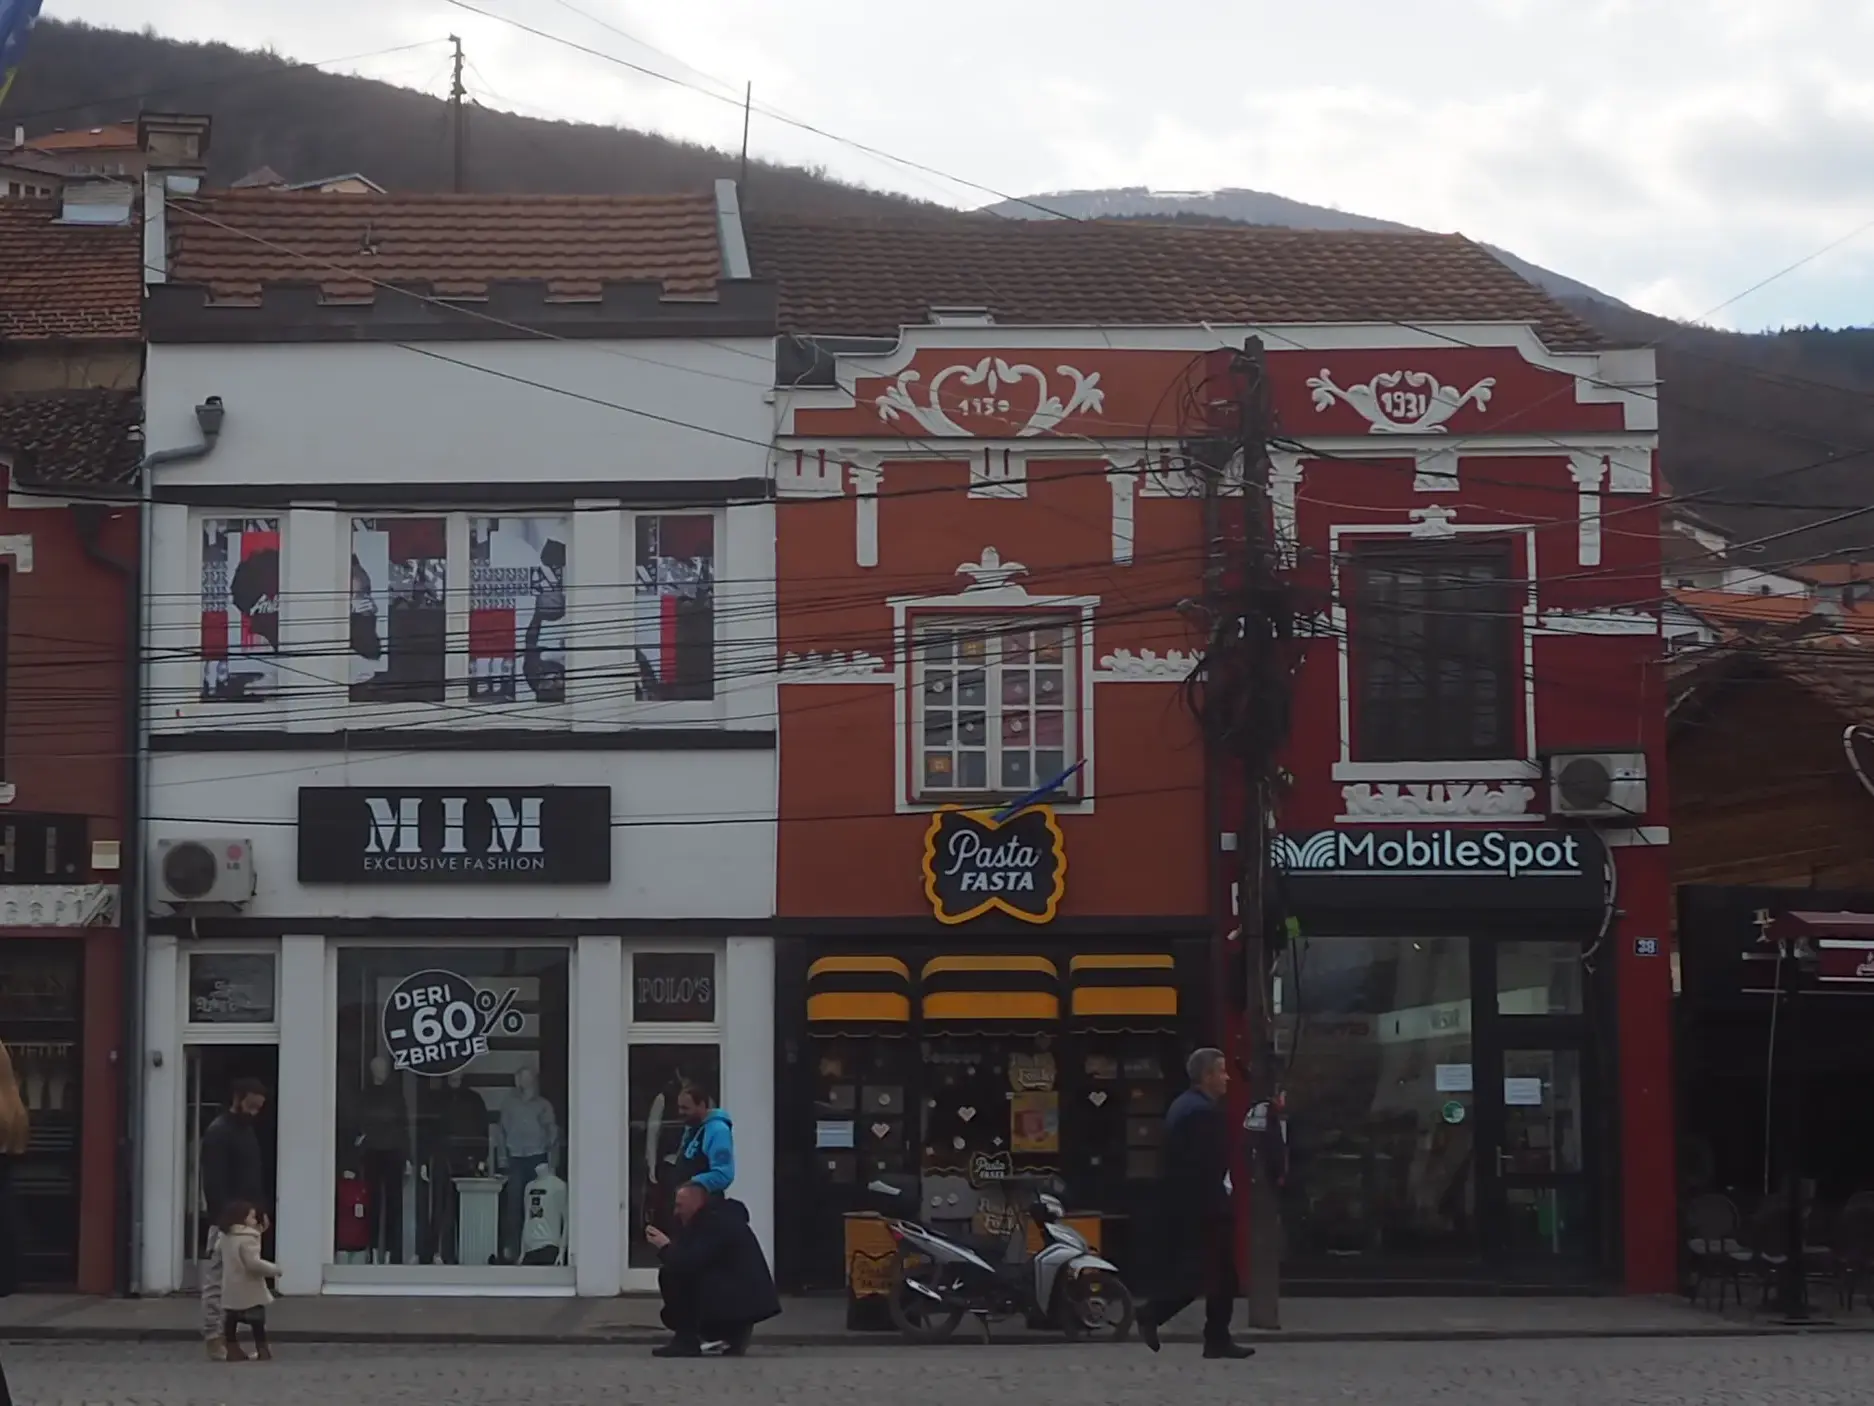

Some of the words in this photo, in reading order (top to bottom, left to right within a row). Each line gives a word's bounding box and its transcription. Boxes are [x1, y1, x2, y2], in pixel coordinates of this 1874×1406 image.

[1381, 391, 1426, 418] 1931
[364, 797, 545, 853] MIM
[364, 856, 457, 871] EXCLUSIVE
[464, 856, 546, 871] FASHION
[944, 829, 1041, 875] Pasta
[1338, 829, 1579, 878] MobileSpot
[960, 871, 1034, 891] FASTA
[394, 984, 451, 1011] DERI
[637, 976, 711, 1003] POLO'S
[395, 1036, 488, 1067] ZBRITJE
